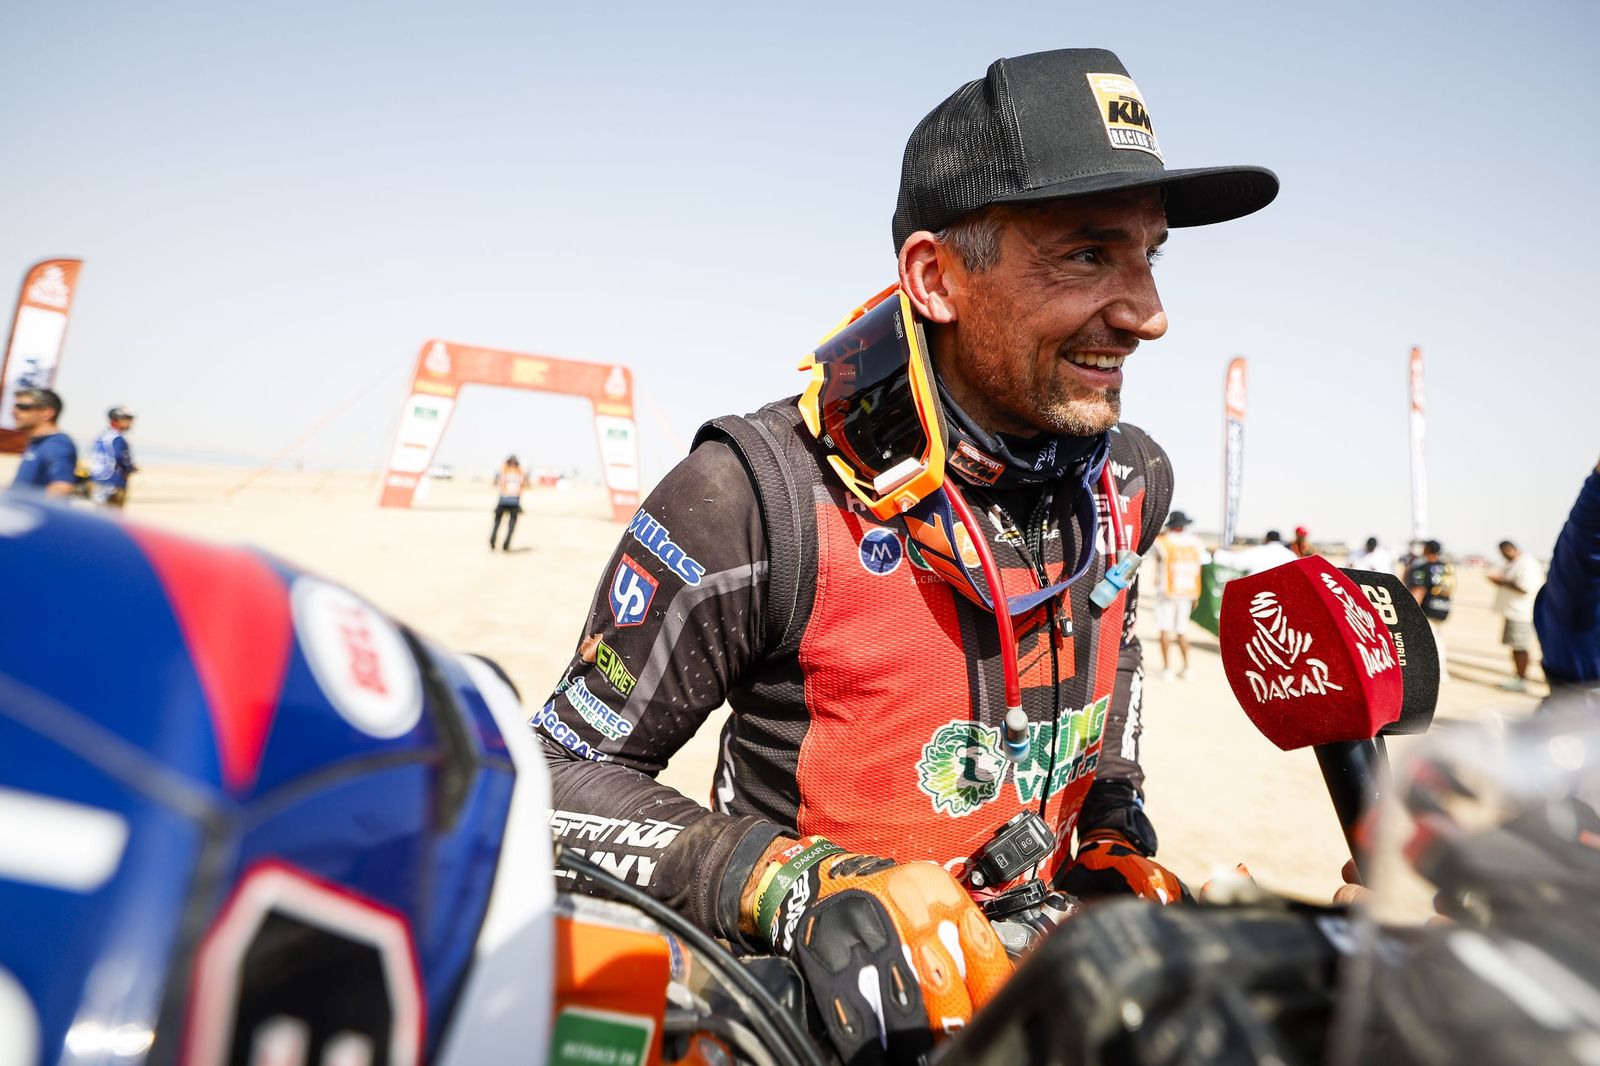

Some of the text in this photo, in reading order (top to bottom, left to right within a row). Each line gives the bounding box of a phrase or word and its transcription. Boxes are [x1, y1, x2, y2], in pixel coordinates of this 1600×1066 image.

[628, 507, 707, 587] Mitas
[1244, 658, 1344, 704] DAKAR
[612, 817, 686, 849] KTM
[792, 846, 825, 871] DAKAR
